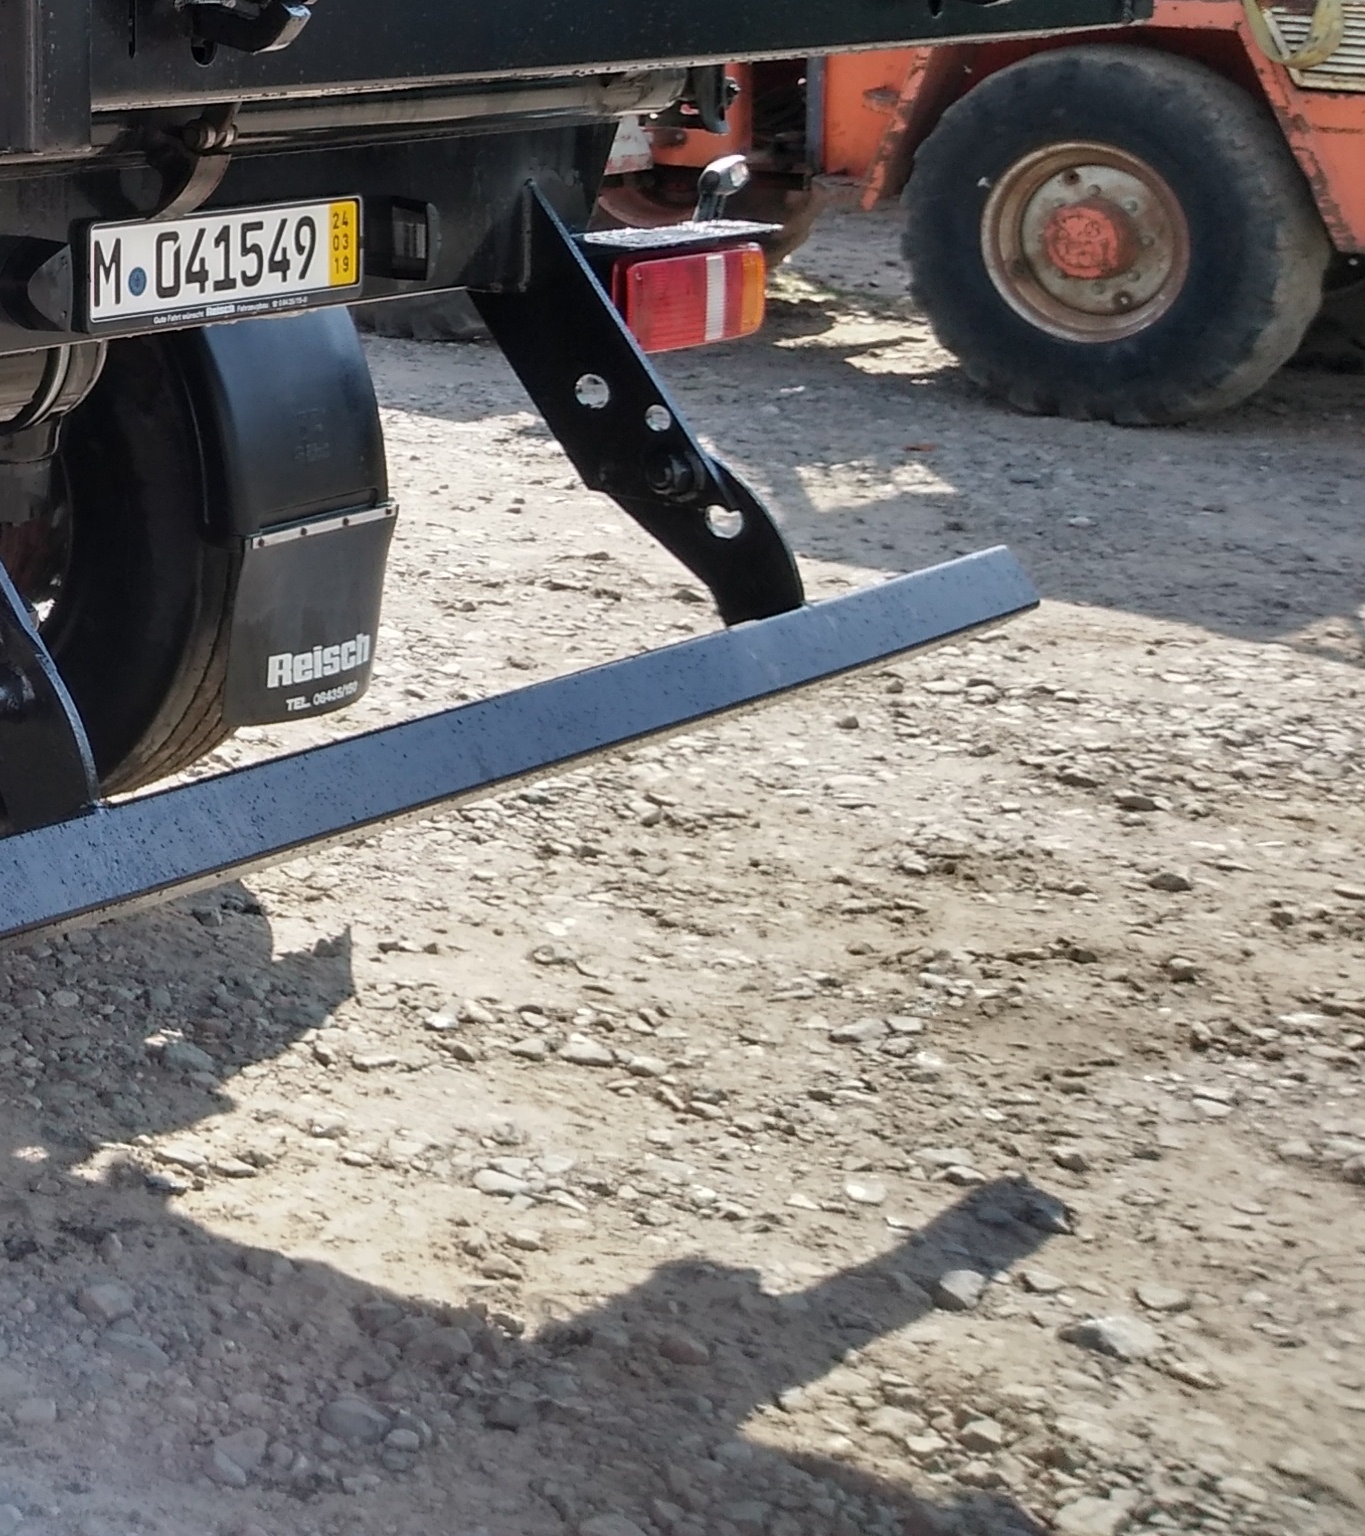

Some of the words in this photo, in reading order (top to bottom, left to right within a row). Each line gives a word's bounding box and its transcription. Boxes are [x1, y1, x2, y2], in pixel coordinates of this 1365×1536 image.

[332, 210, 349, 230] 24
[332, 232, 349, 252] 03
[92, 237, 121, 308] M
[154, 215, 317, 299] 041549
[334, 255, 350, 275] 19
[266, 632, 371, 689] Reisch
